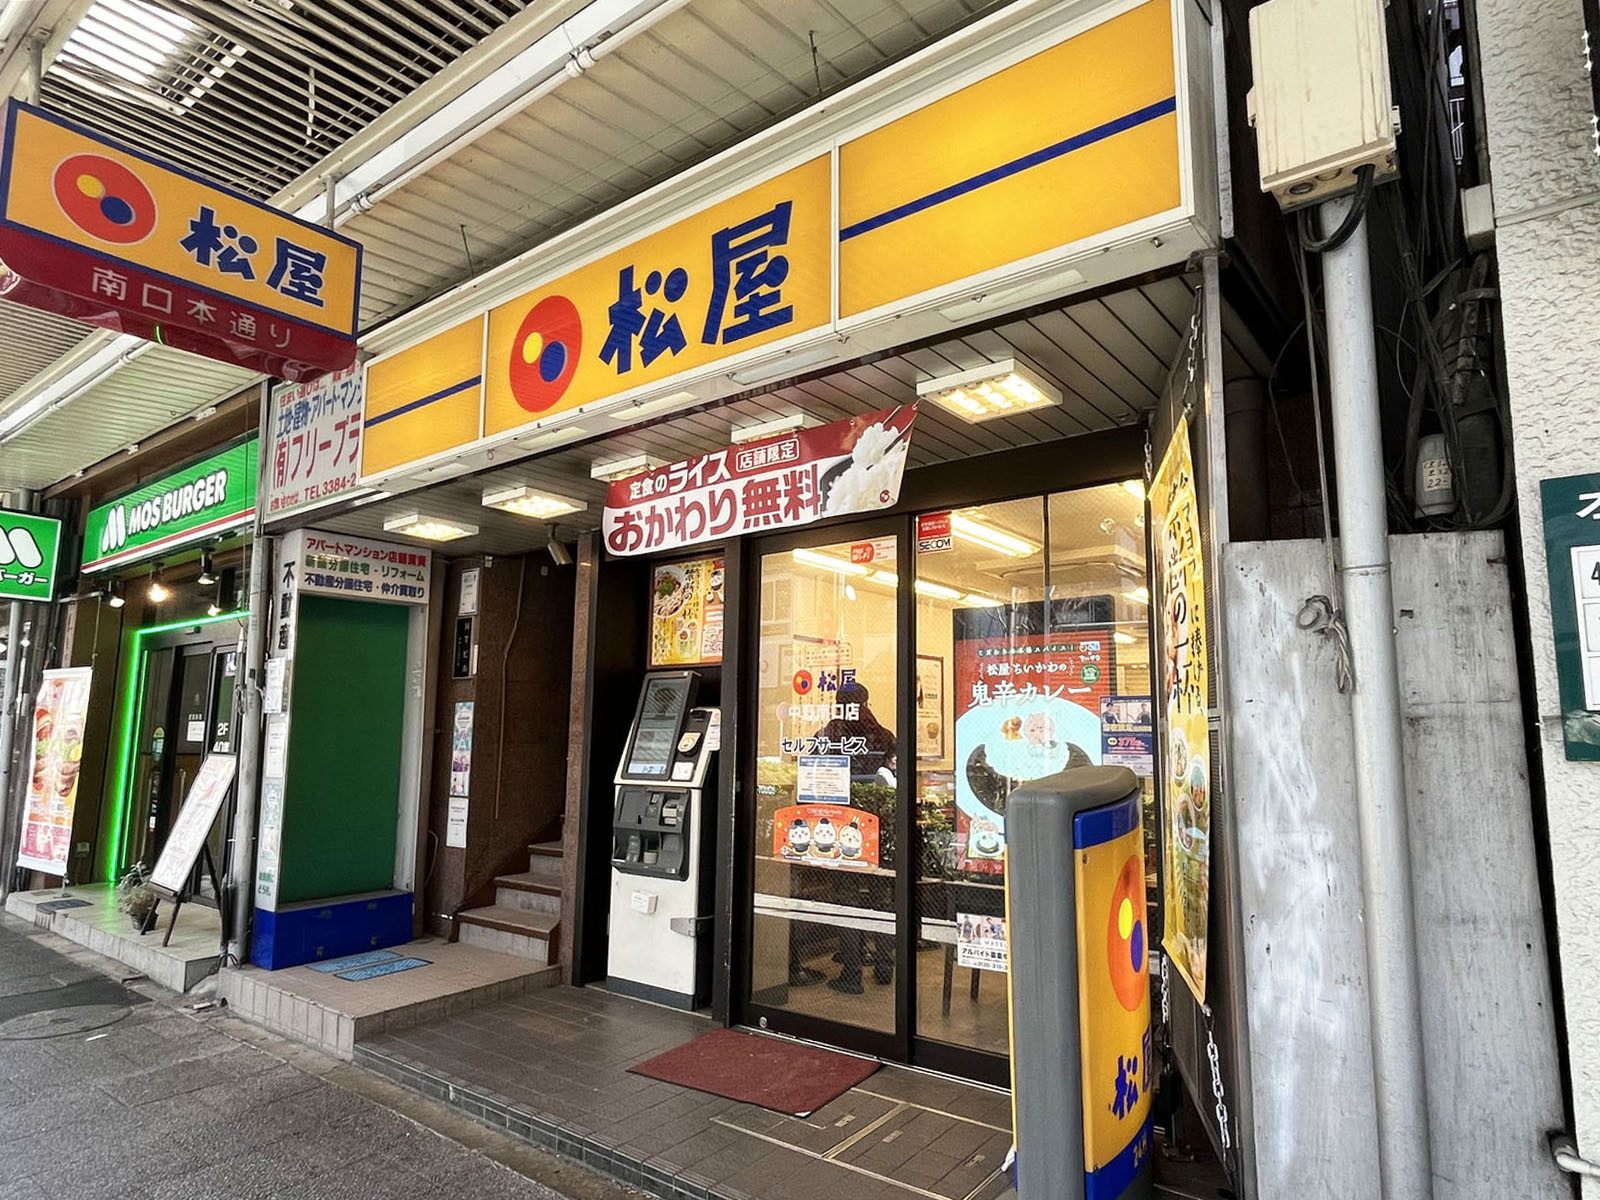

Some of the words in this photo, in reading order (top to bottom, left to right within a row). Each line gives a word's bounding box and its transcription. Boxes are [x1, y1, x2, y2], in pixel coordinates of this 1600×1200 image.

[178, 205, 327, 308] 松屋
[91, 266, 292, 349] 南口本通り
[598, 200, 793, 375] 松屋
[629, 450, 732, 501] 定食のライス
[738, 440, 797, 472] 店舗限定
[128, 496, 160, 535] MOS
[161, 470, 227, 523] BURGER
[608, 463, 822, 552] おかわり無料
[919, 538, 951, 550] SECOM
[817, 669, 857, 692] 松屋
[967, 679, 1092, 708] 鬼辛カレー
[781, 736, 869, 755] セルフサービス
